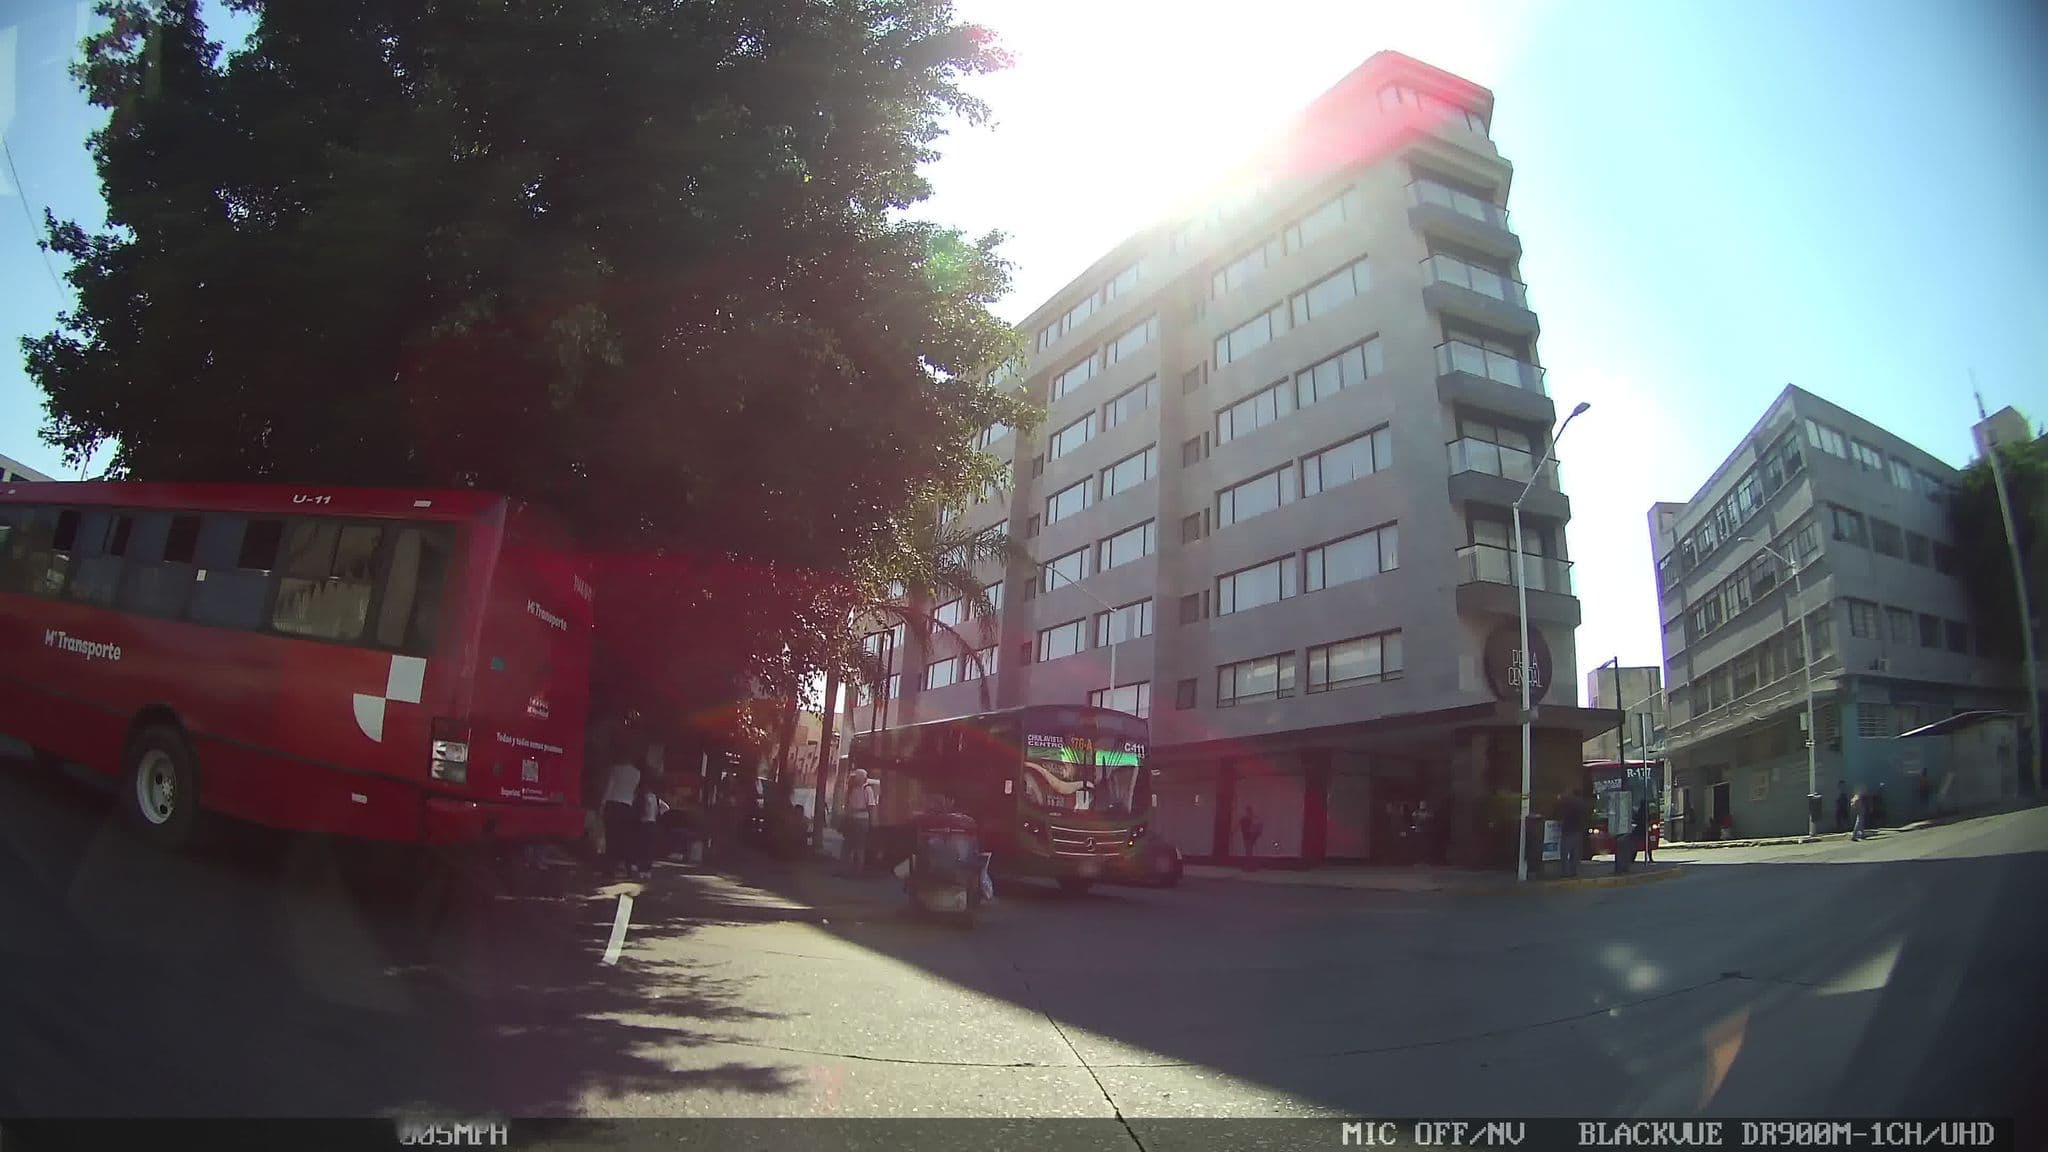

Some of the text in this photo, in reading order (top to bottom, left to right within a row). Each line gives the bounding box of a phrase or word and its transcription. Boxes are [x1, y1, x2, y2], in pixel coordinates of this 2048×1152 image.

[293, 494, 331, 505] U-11
[58, 631, 122, 661] Transporte
[1124, 742, 1145, 755] C-111
